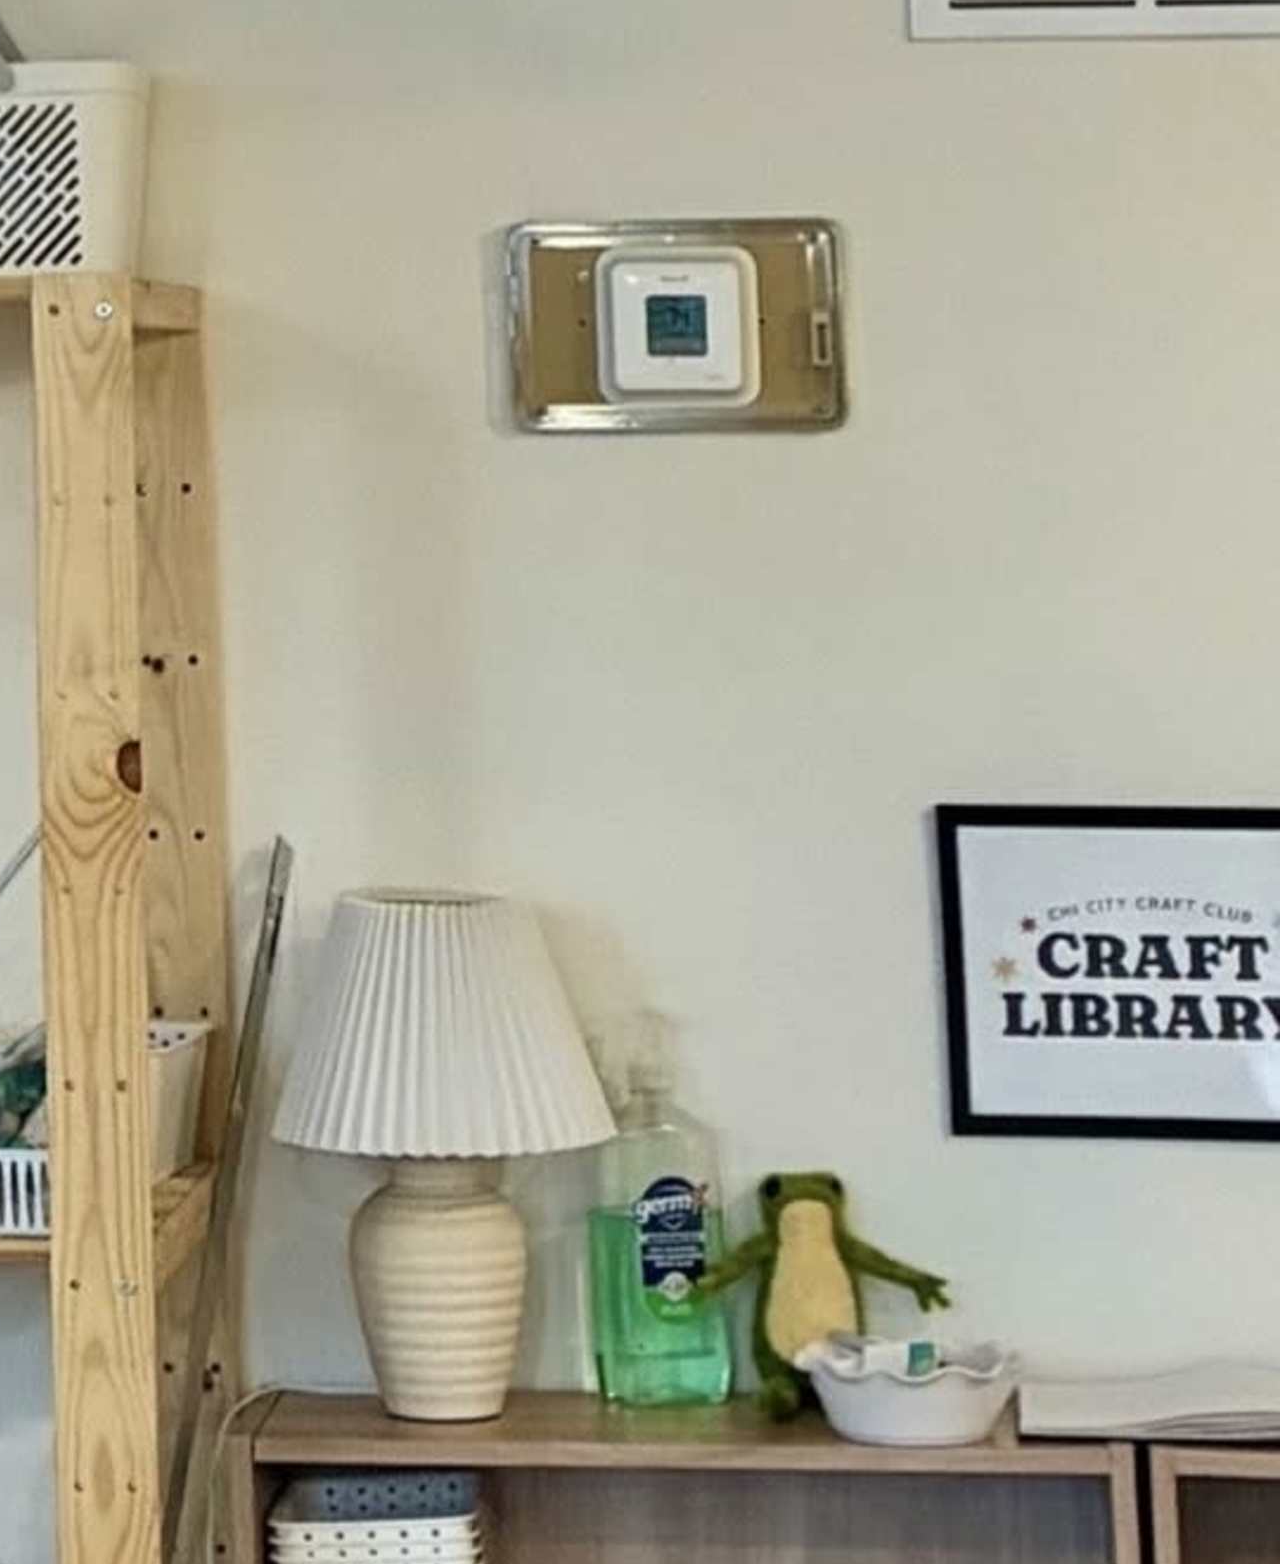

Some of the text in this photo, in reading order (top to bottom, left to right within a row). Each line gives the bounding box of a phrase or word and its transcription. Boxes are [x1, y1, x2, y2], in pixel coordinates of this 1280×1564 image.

[1047, 895, 1253, 924] CHI CITY CRAFT CLUB
[1036, 931, 1269, 981] CRAFT
